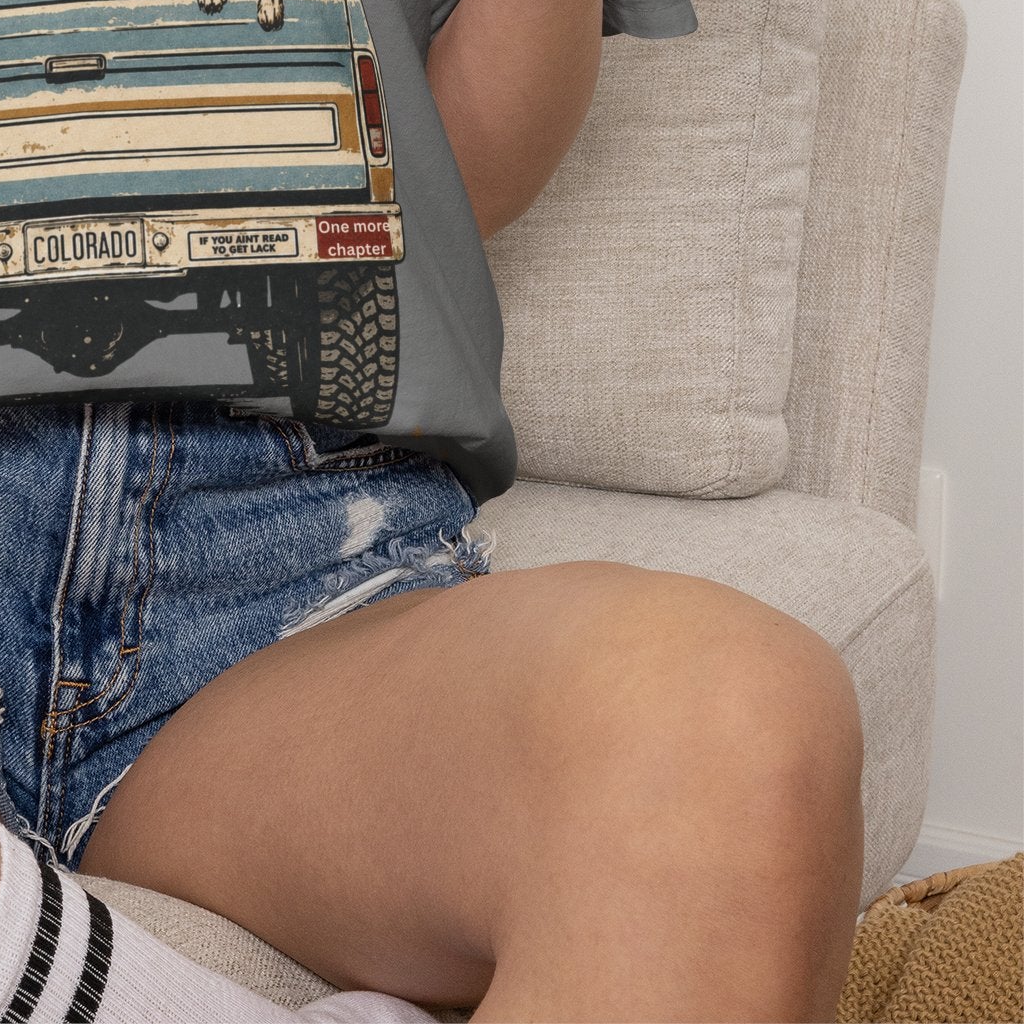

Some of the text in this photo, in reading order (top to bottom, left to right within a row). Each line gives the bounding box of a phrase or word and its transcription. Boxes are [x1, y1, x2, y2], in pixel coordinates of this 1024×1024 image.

[318, 220, 391, 234] One more
[199, 233, 289, 246] IF YOU AINT READ
[33, 230, 137, 264] COLORADO
[212, 243, 276, 255] YO GET LACK
[327, 242, 387, 259] chapter
